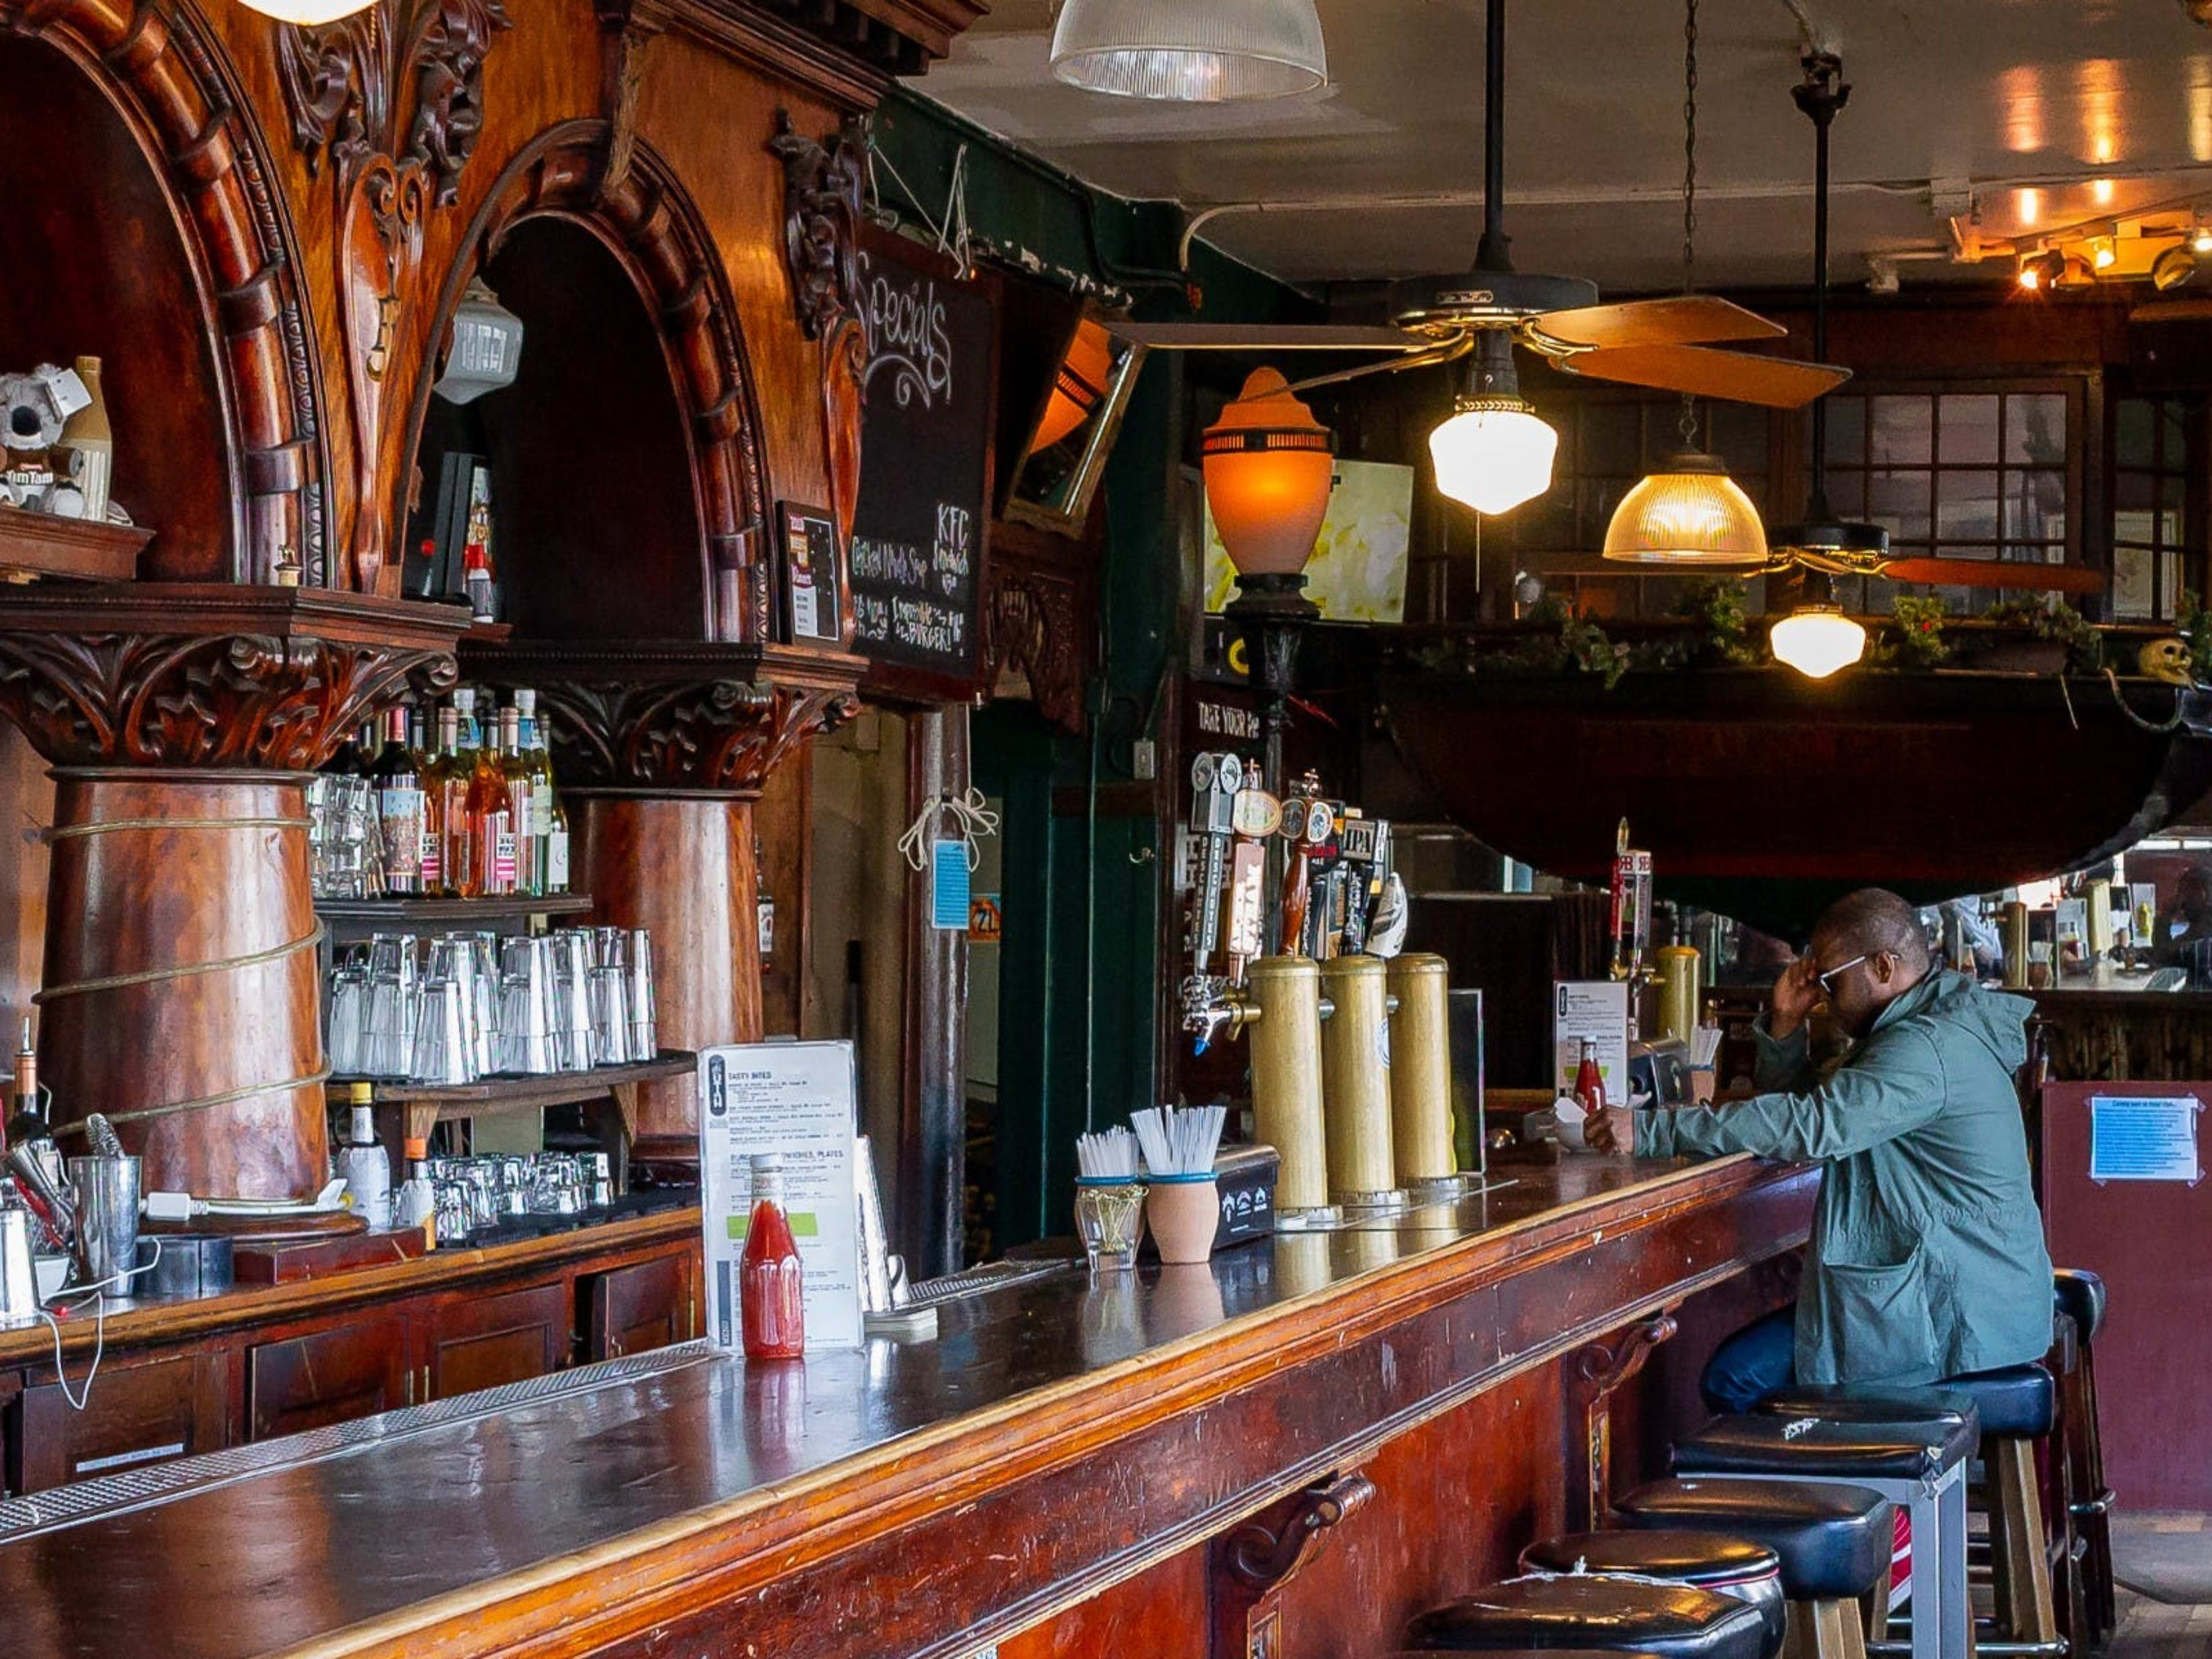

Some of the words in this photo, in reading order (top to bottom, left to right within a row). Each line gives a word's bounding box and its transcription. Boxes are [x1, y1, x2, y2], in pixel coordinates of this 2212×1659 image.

[855, 251, 951, 403] Specials
[937, 503, 969, 550] KFC
[1199, 702, 1221, 733] TAKE
[1222, 705, 1245, 737] YOUR
[1345, 828, 1373, 854] IPA
[1206, 836, 1222, 946] DESCHUTES
